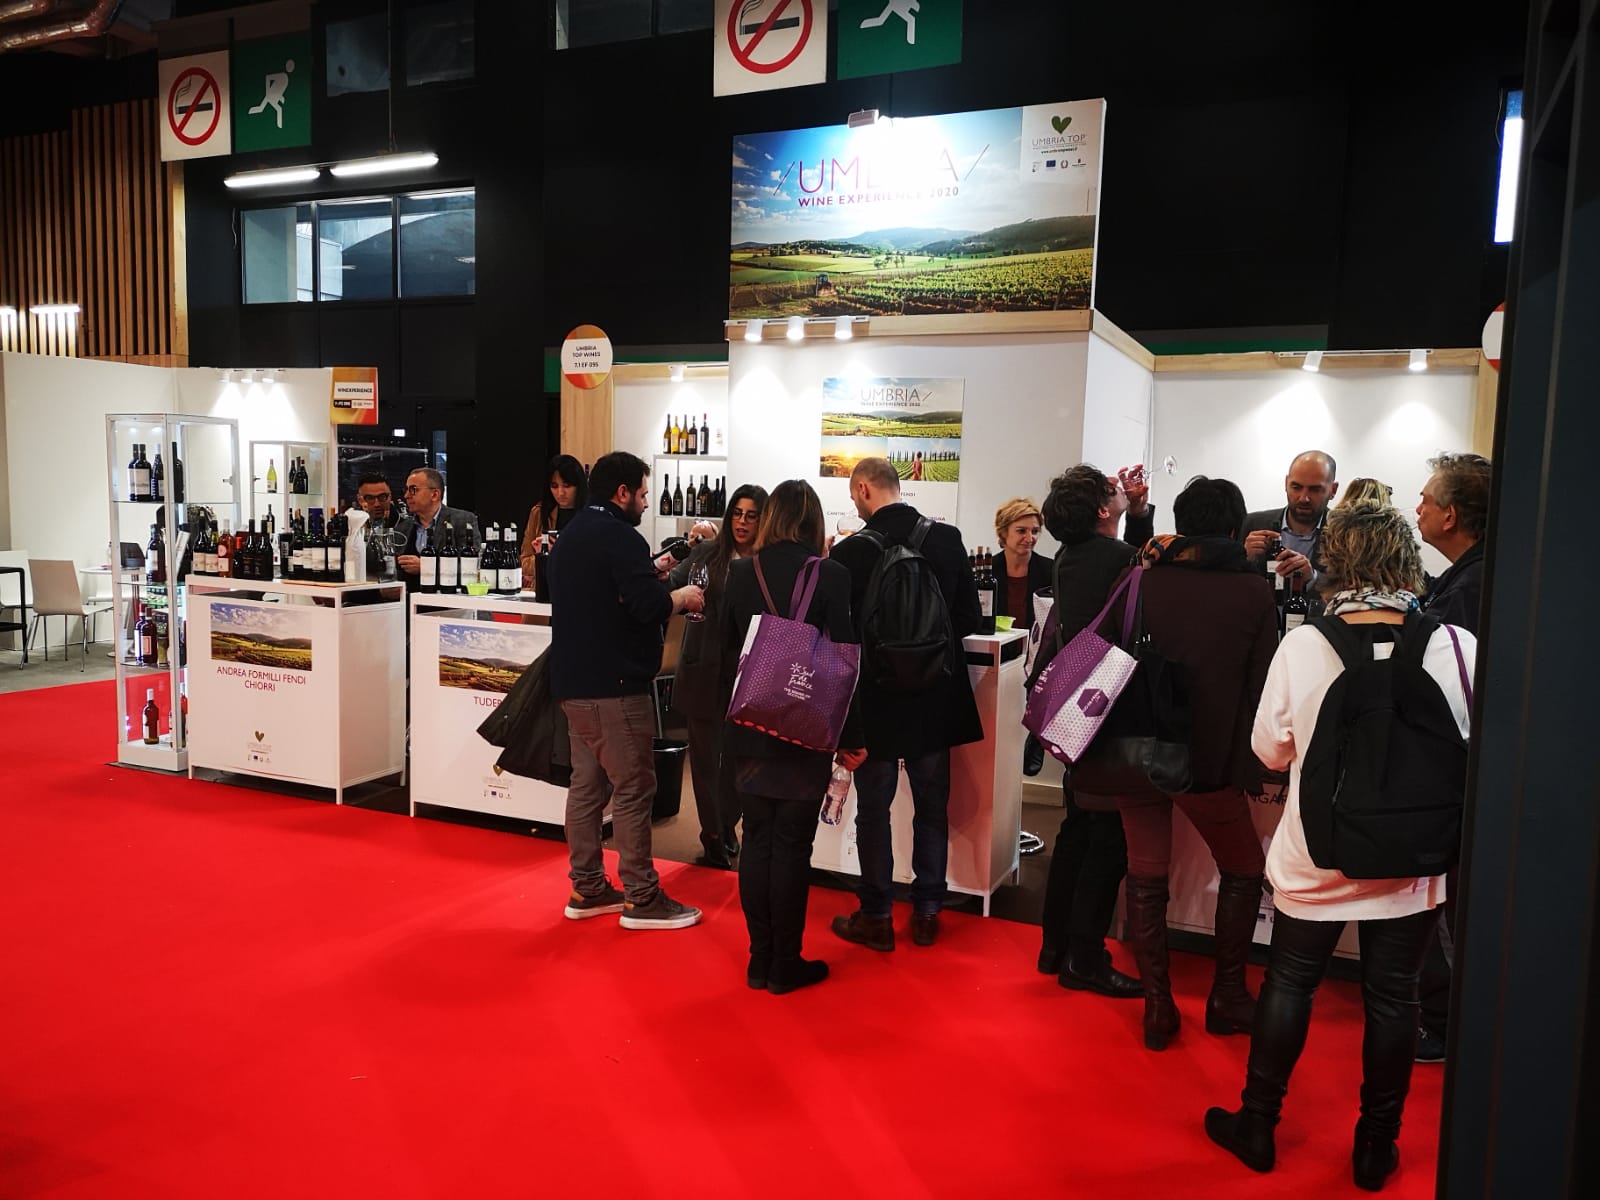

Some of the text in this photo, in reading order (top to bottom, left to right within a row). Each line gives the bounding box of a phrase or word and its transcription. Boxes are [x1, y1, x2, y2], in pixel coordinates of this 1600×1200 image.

[1032, 136, 1066, 146] UMBRIA
[1067, 134, 1086, 142] TOP
[798, 196, 833, 208] WINE
[929, 186, 959, 199] 2020
[217, 666, 306, 685] ANDREA FORMILLI FENDI
[244, 680, 276, 692] CHIORRI
